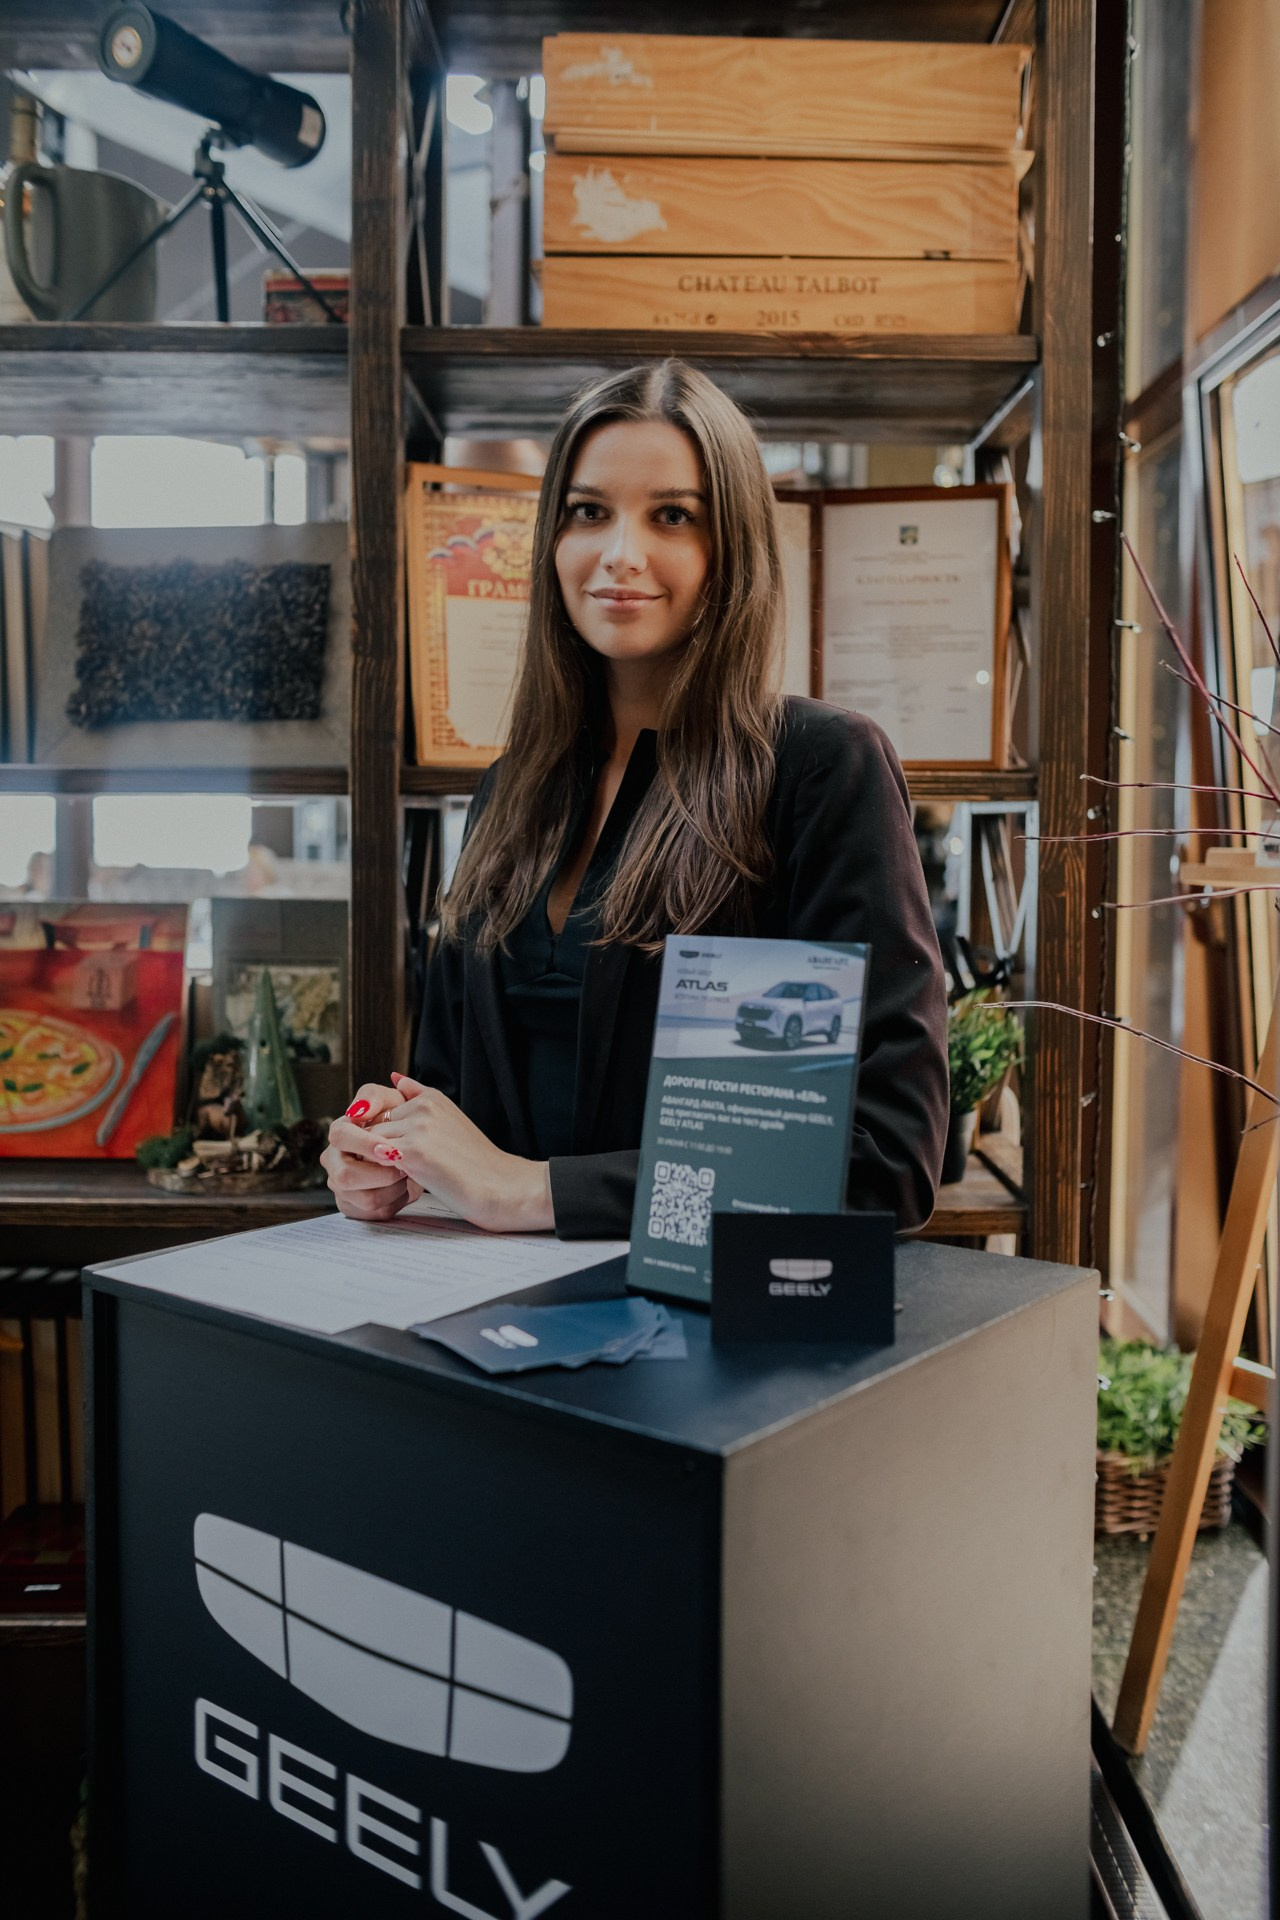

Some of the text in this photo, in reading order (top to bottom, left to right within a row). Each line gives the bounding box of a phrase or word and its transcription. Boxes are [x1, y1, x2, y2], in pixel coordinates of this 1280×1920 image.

[678, 275, 881, 295] CHATEAU TALBOT
[755, 309, 801, 327] 2015
[467, 579, 531, 600] ГРАМ
[675, 979, 729, 992] ATLAS
[663, 1074, 707, 1090] ДОРОГИЕ
[707, 1079, 739, 1093] ГОСТИ
[739, 1083, 795, 1101] РЕСТОРАНА
[768, 1282, 832, 1296] GEELY
[195, 1697, 573, 1920] GEELY
